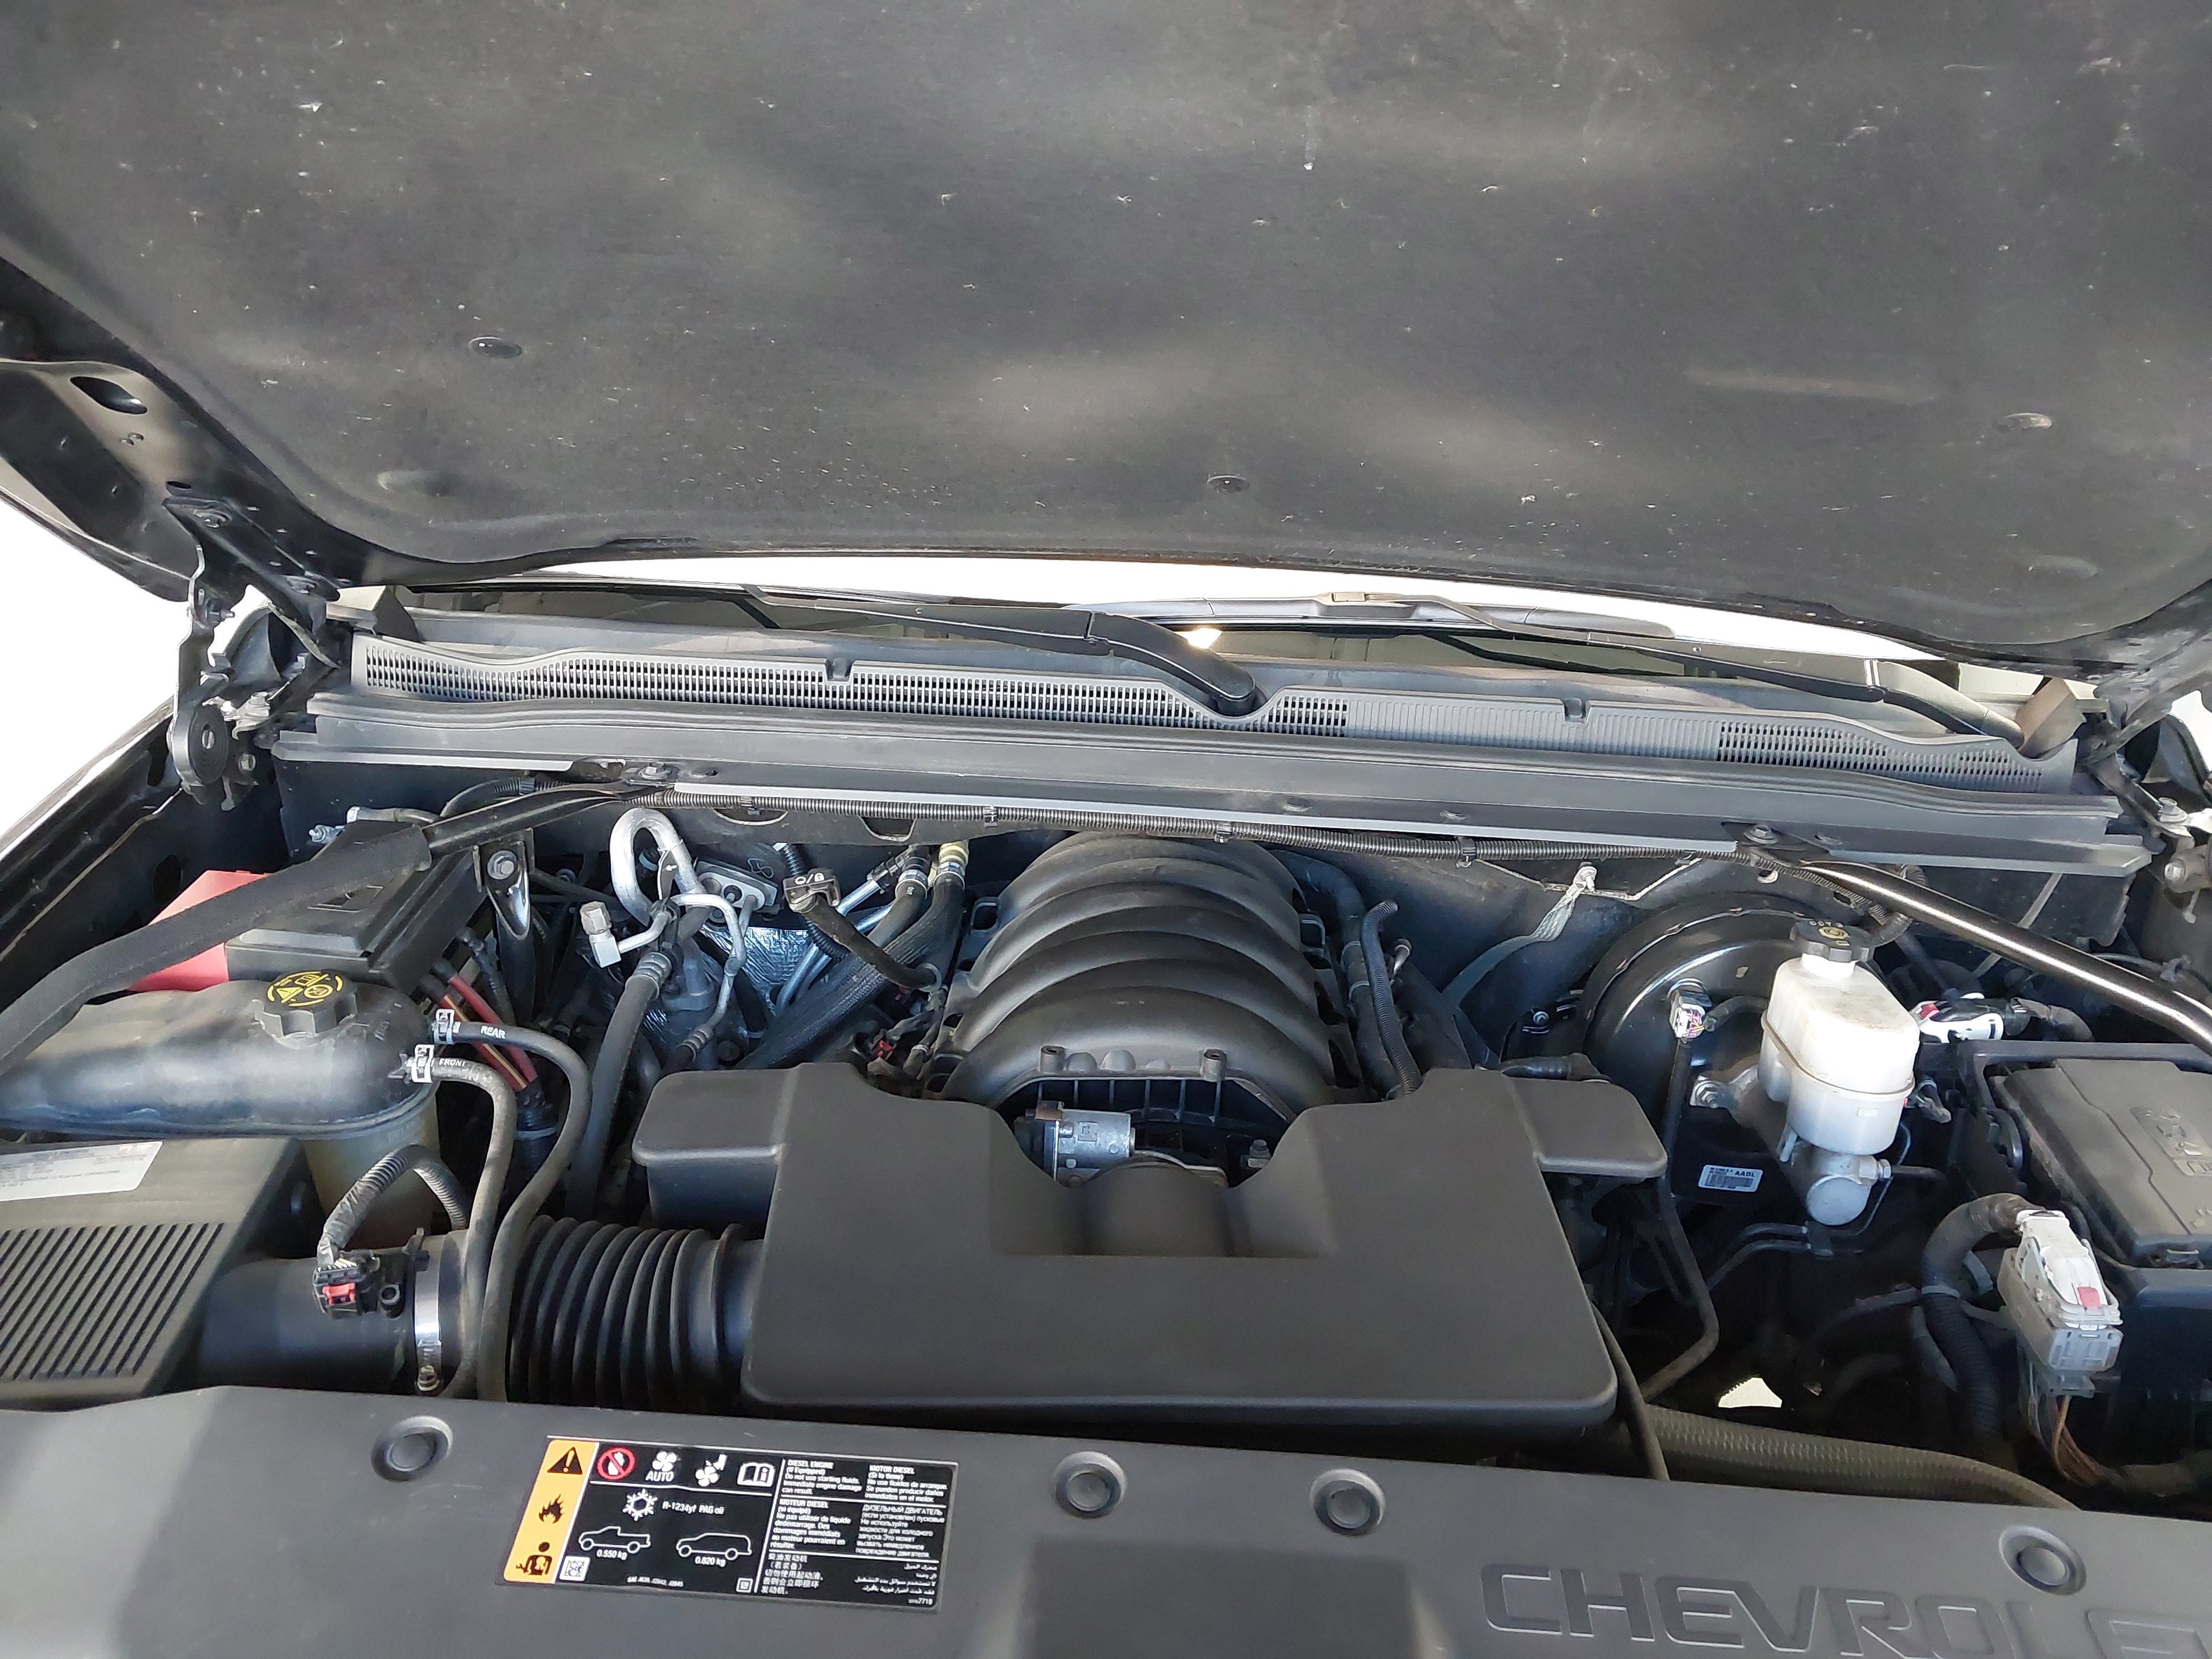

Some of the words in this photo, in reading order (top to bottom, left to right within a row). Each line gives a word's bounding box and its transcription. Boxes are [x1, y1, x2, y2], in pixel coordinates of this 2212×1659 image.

[480, 1025, 506, 1039] REAR
[439, 1058, 467, 1066] FRONT
[645, 1470, 674, 1482] AUTO
[662, 1501, 697, 1514] R-1234yf
[698, 1504, 714, 1514] PAG
[715, 1506, 725, 1515] oil
[780, 1499, 806, 1507] MOTEUR
[596, 1549, 618, 1558] 0.550
[618, 1551, 627, 1560] kg
[695, 1555, 715, 1565] 0.820
[716, 1558, 726, 1567] kg
